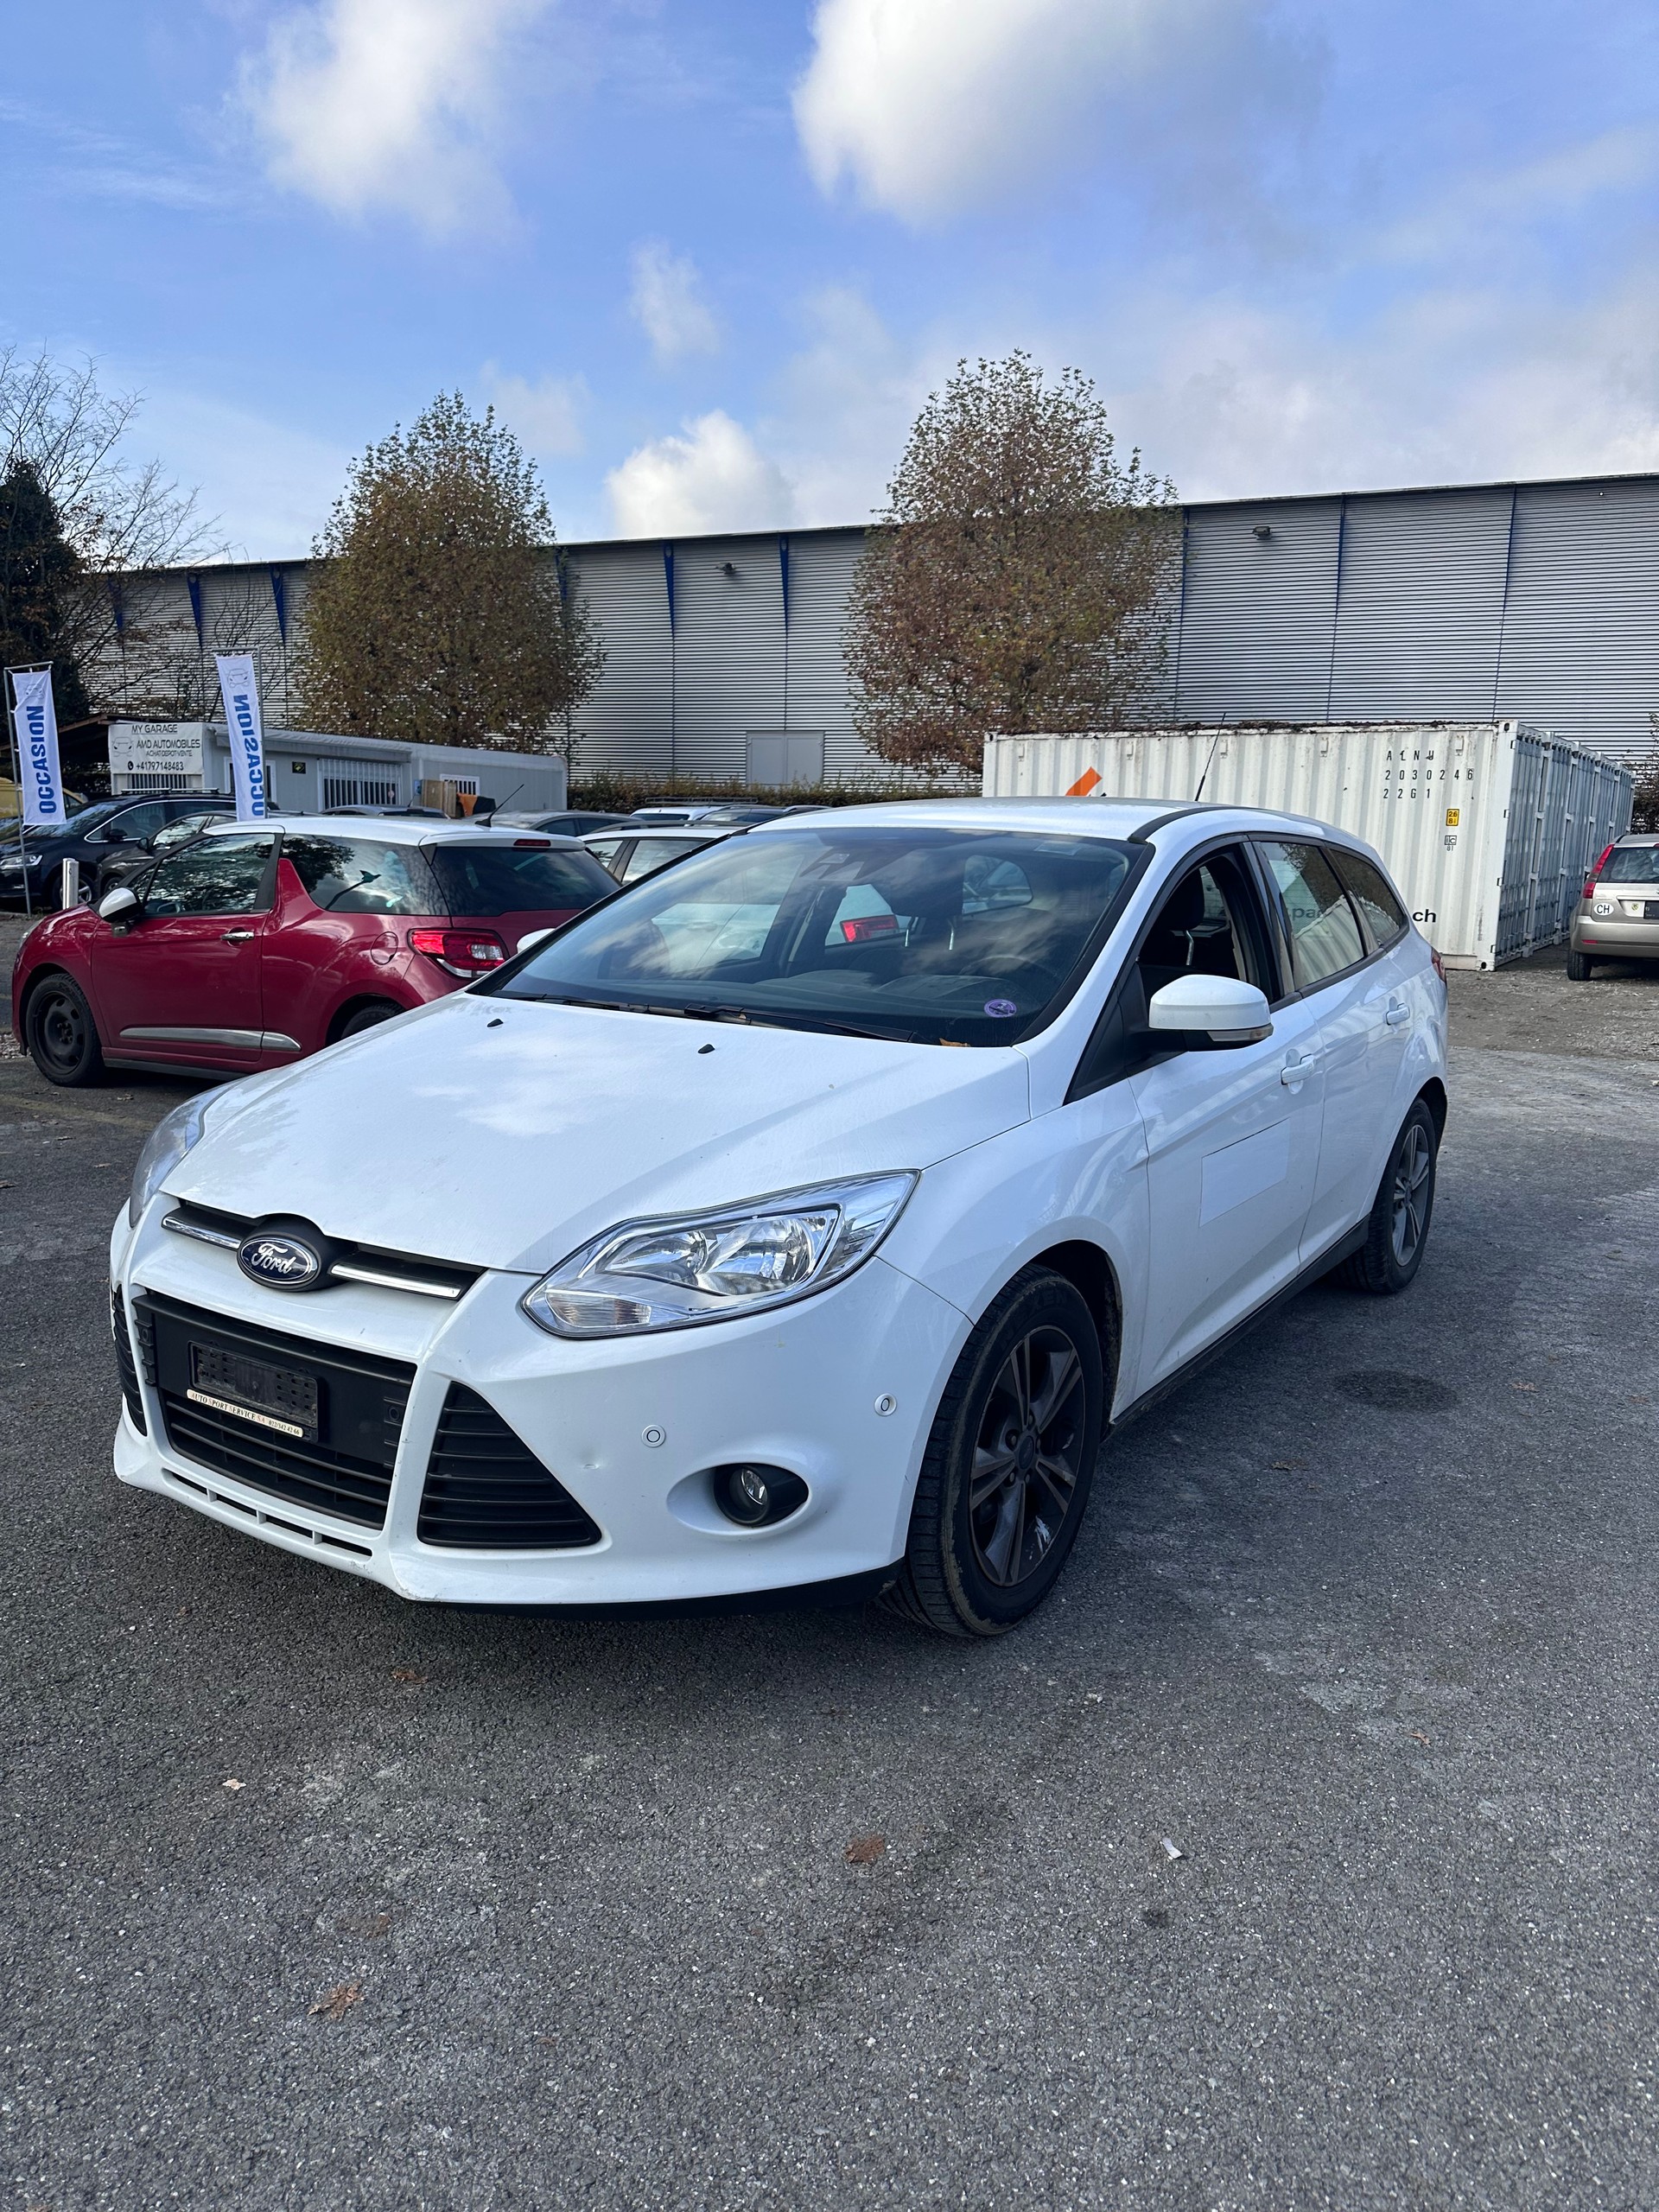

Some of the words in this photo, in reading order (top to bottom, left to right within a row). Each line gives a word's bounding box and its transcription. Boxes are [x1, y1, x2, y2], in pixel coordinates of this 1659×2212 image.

[131, 724, 143, 734] MY
[144, 724, 178, 734] GARAGE
[137, 740, 152, 749] AMD
[153, 740, 200, 749] AUTOMOBILES
[26, 705, 57, 814] OCCASION
[1384, 768, 1473, 780] 2030246
[1382, 788, 1431, 799] 22G1
[1596, 904, 1611, 914] CH
[1412, 908, 1437, 923] ch
[251, 1243, 296, 1274] Ford
[191, 1393, 207, 1403] AUTO
[208, 1398, 228, 1411] SPORT
[228, 1404, 256, 1420] SERVICE
